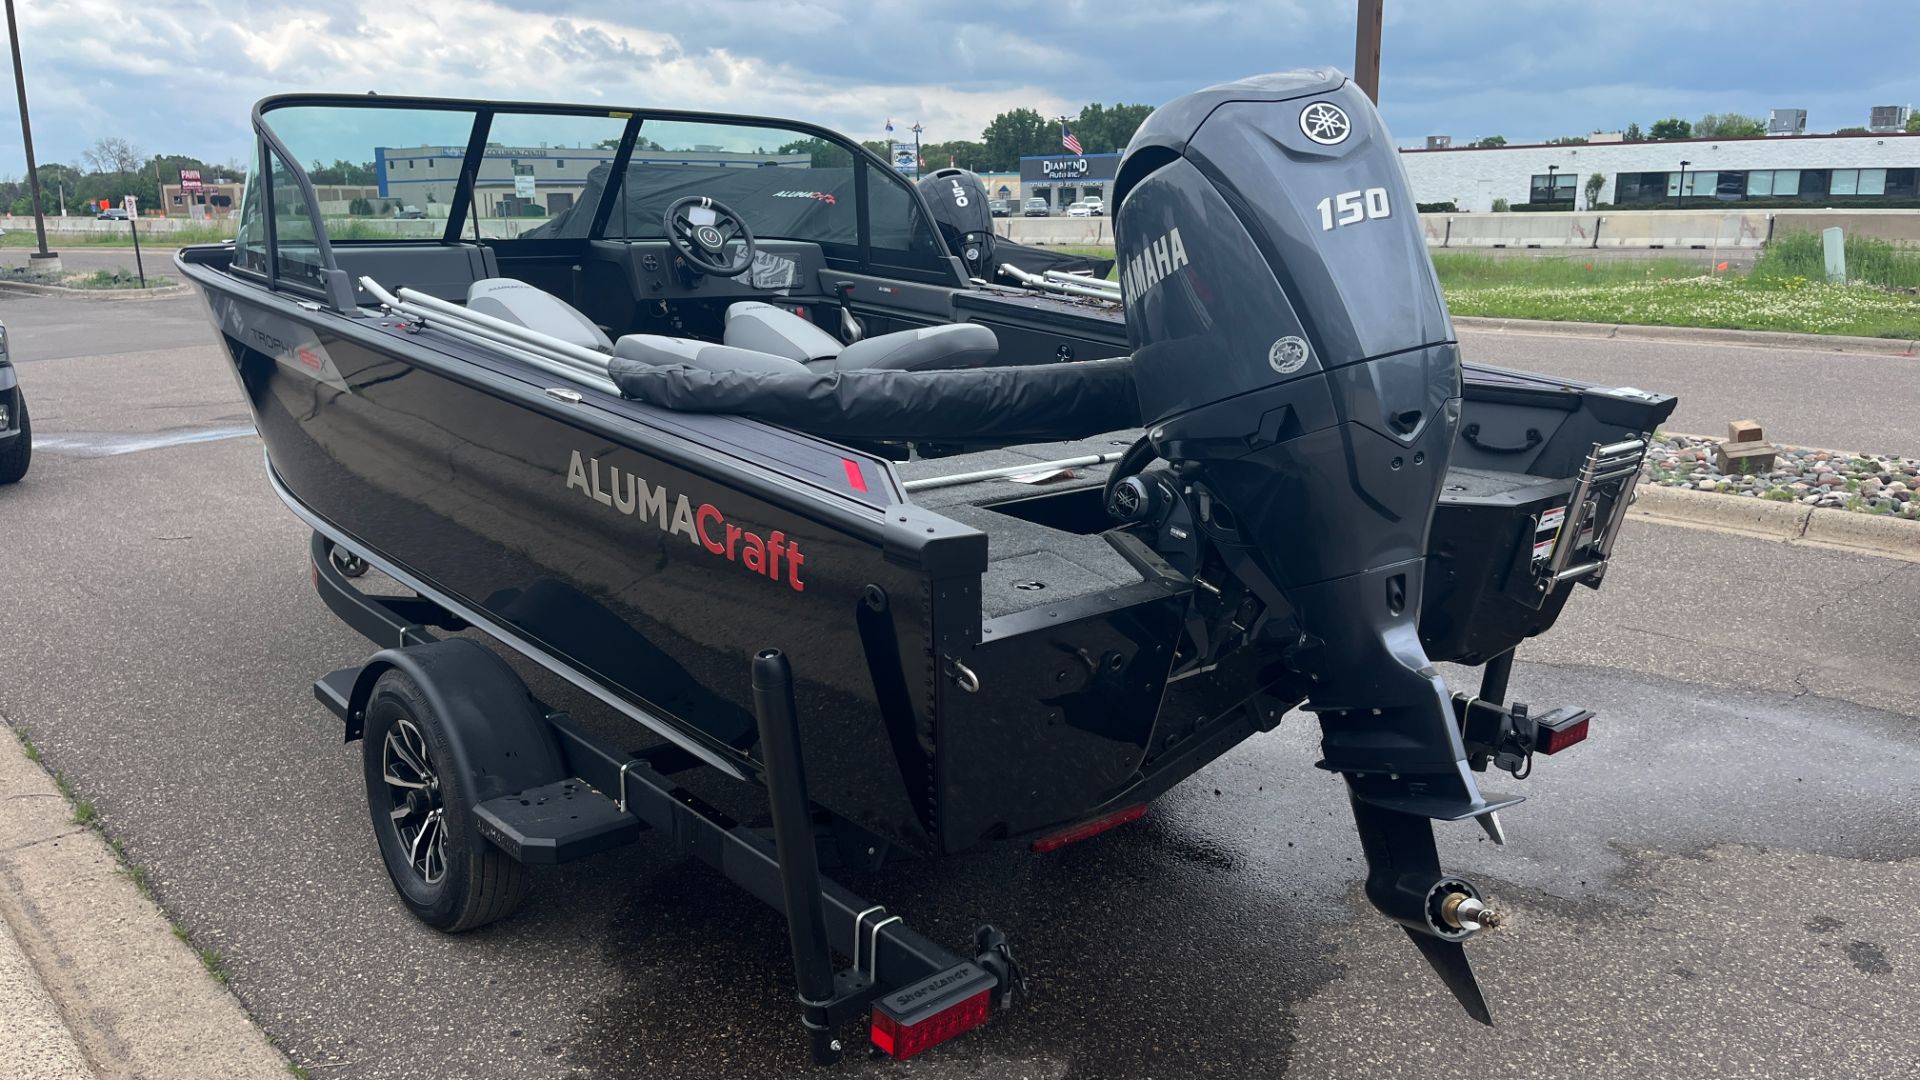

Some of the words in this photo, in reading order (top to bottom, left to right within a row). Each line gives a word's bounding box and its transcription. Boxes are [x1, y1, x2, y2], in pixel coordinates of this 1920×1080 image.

[181, 169, 201, 179] PAWN
[1049, 171, 1067, 179] Auto
[951, 179, 969, 207] 150
[1316, 187, 1391, 231] 150
[1122, 227, 1189, 305] YAMAHA
[250, 327, 298, 359] TROPHY
[566, 449, 805, 592] ALUMACraft
